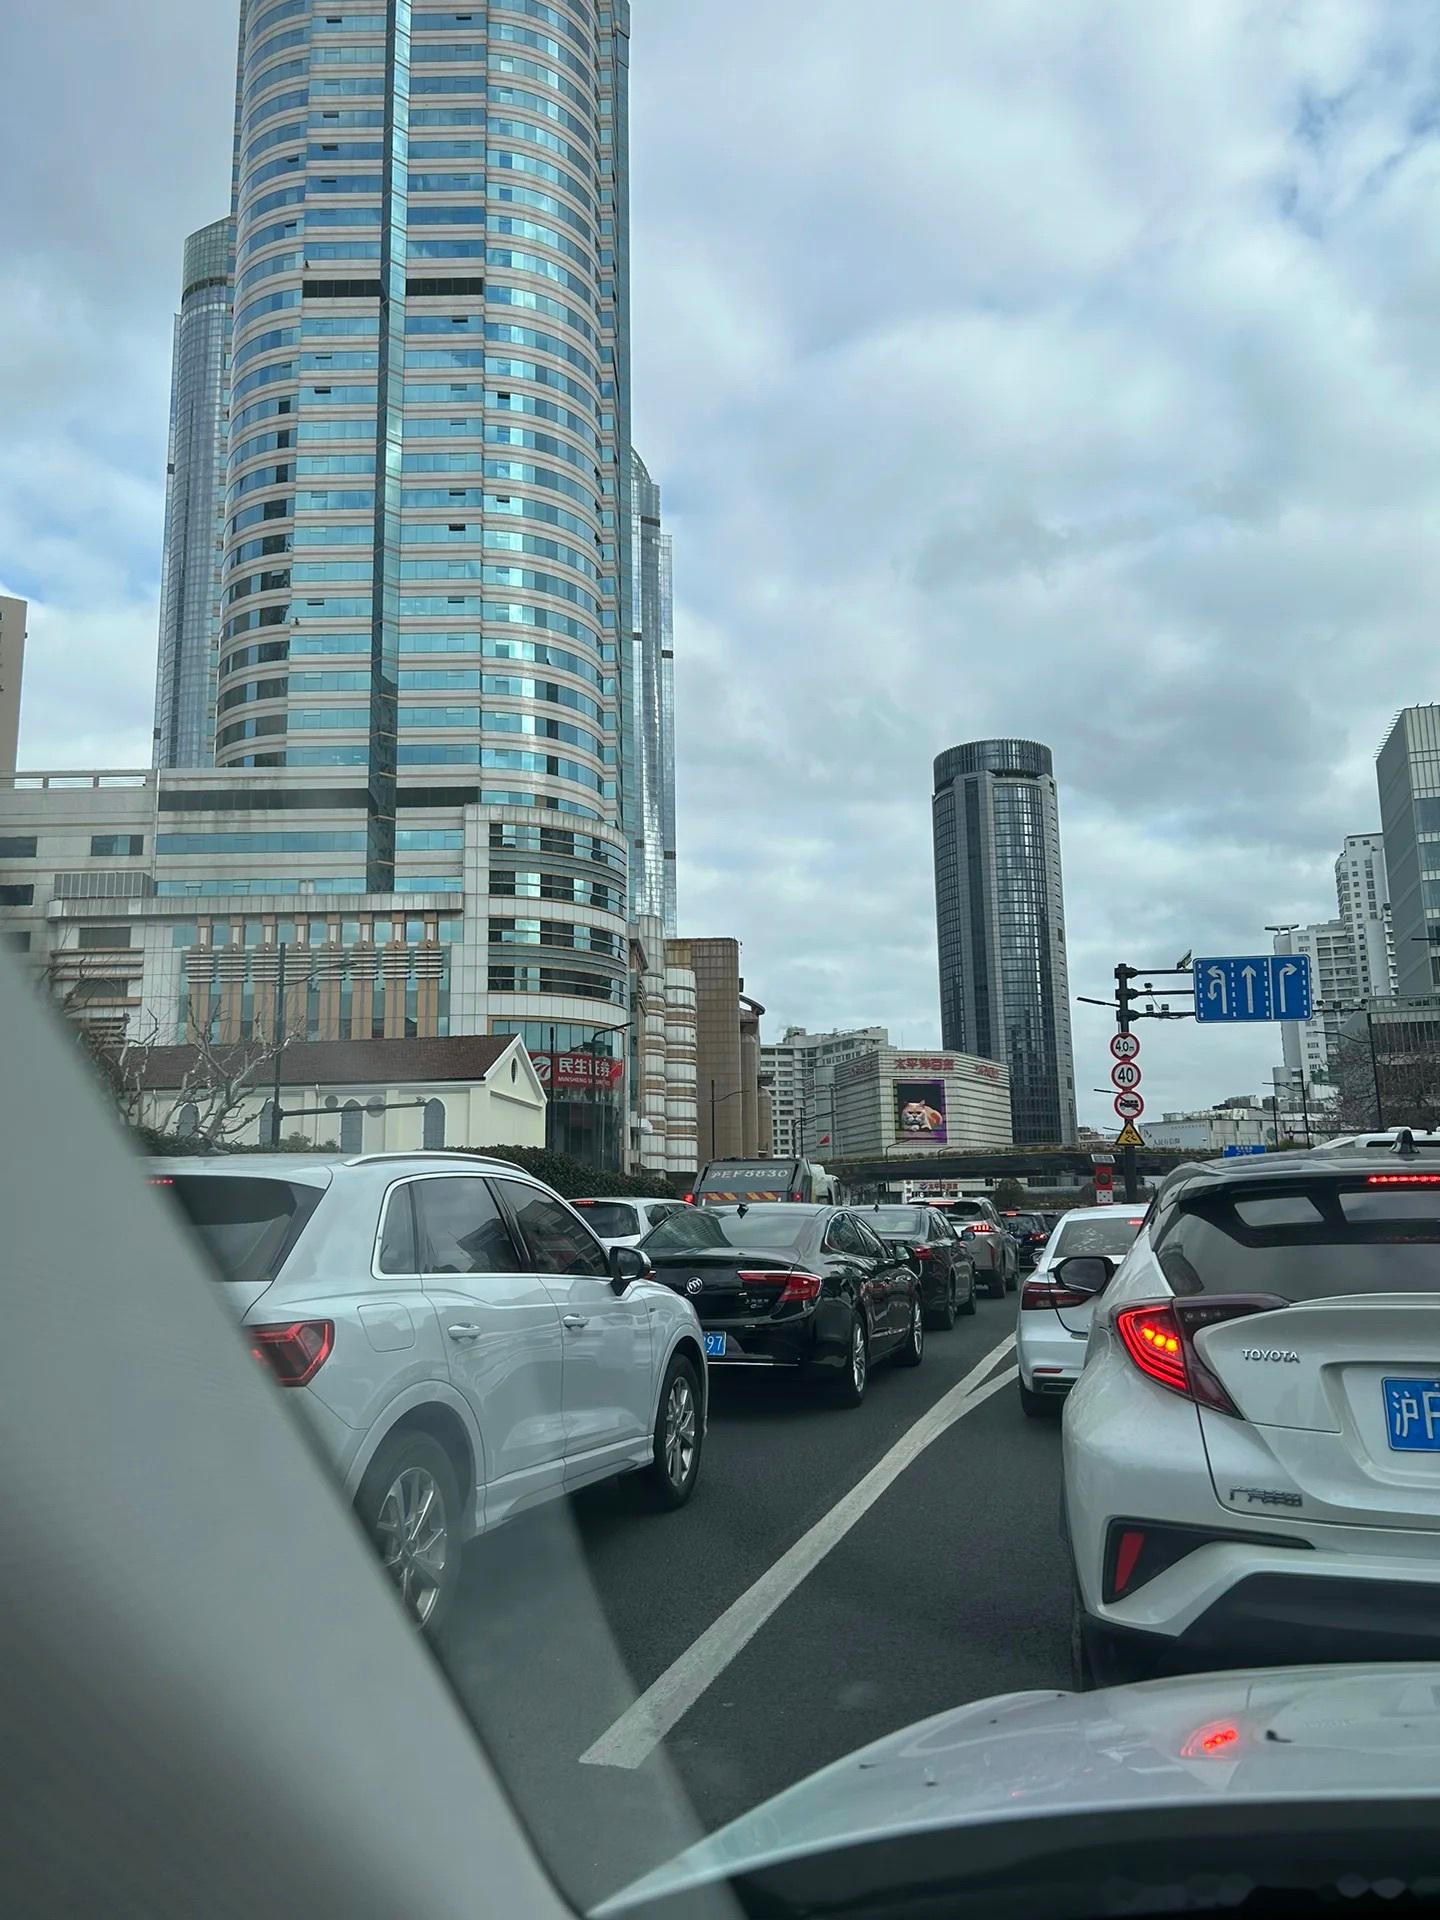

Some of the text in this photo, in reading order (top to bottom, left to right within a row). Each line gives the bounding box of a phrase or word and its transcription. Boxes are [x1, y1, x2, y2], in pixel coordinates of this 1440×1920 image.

[558, 1057, 610, 1077] 民生证券
[1117, 1067, 1134, 1083] 40
[703, 1335, 723, 1351] 97
[1242, 1348, 1301, 1364] TOYOTA
